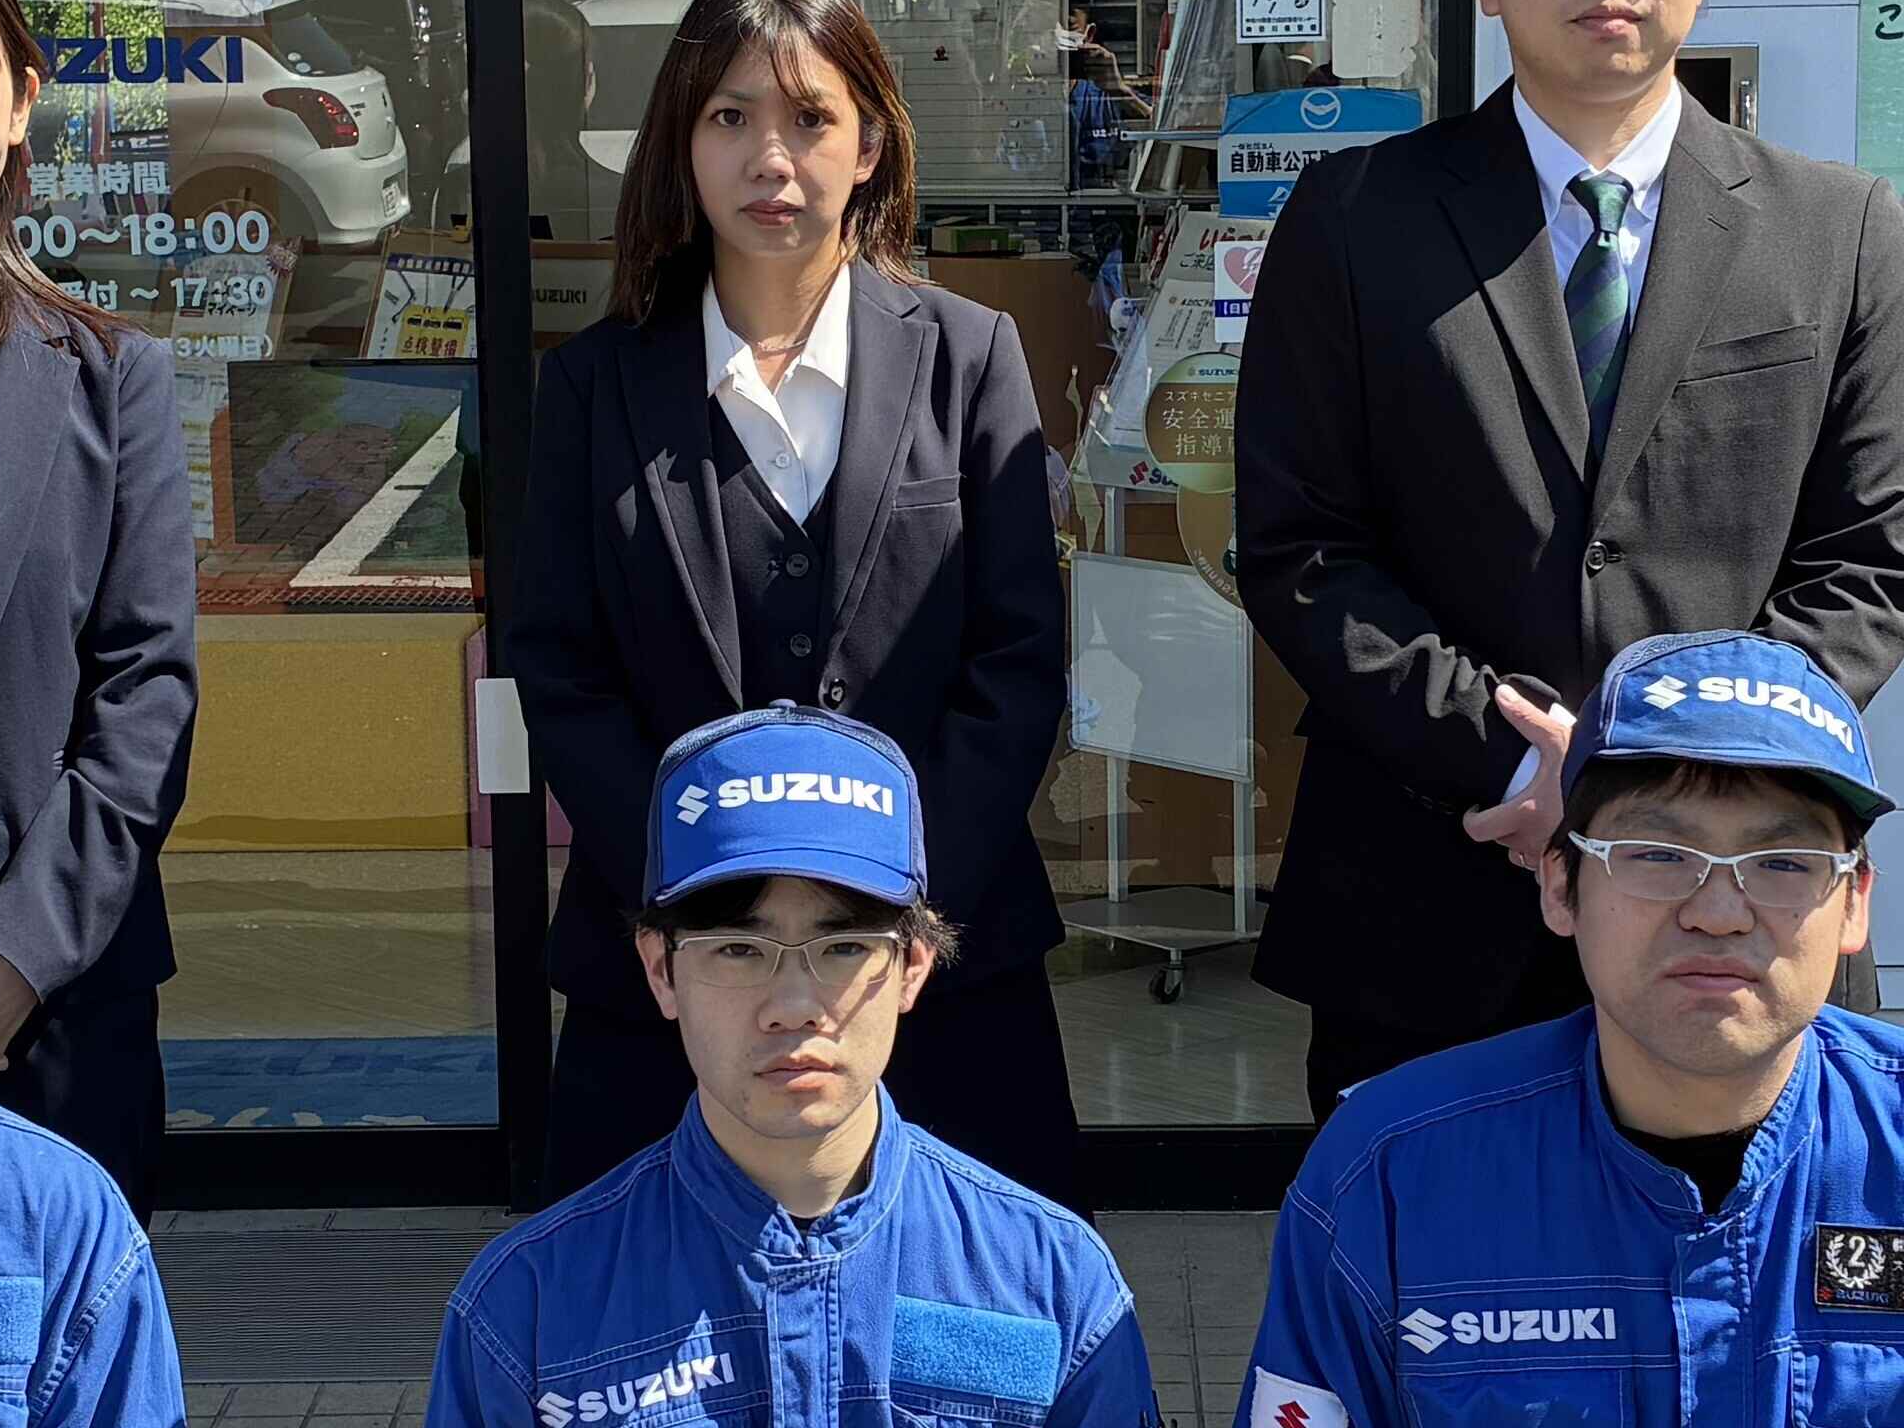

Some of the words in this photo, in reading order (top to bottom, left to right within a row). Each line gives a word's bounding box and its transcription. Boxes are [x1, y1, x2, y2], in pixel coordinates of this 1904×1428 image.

[41, 36, 244, 84] ZUKI
[27, 161, 171, 198] 営業時間
[1231, 149, 1331, 174] 自動車公正
[171, 275, 273, 307] 17:30
[1697, 676, 1855, 755] SUZUKI
[717, 772, 894, 817] SUZUKI
[1848, 1236, 1866, 1268] 2
[1451, 1308, 1616, 1344] SUZUKI
[578, 1353, 736, 1424] SUZUKI
